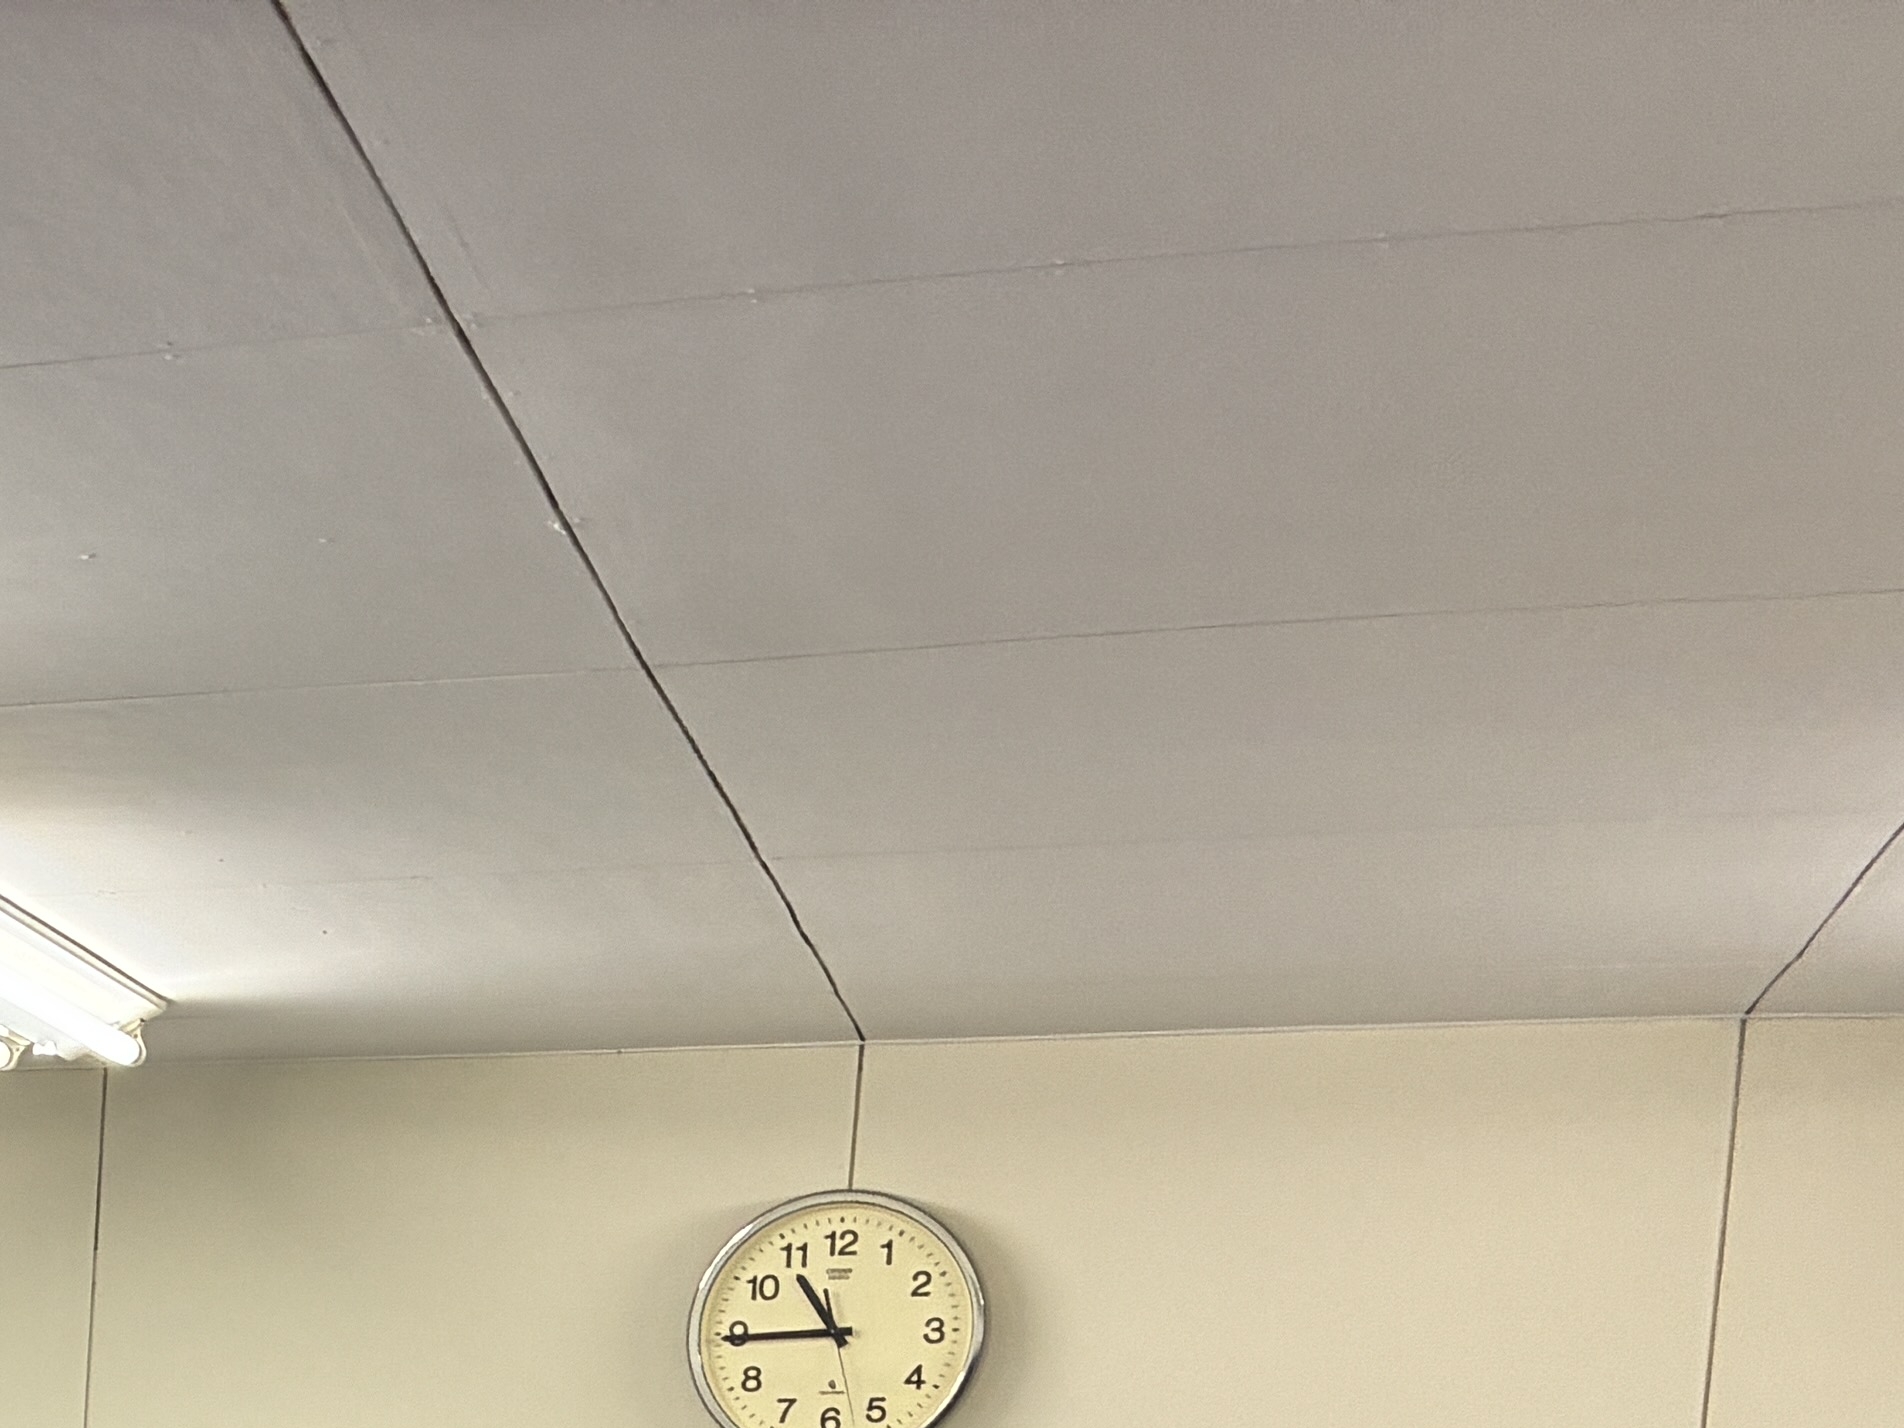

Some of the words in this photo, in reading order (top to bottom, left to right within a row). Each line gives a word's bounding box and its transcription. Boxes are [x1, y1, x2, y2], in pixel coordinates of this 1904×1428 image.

[780, 1243, 809, 1268] 11
[825, 1230, 859, 1256] 12
[880, 1239, 894, 1265] 1
[747, 1275, 780, 1300] 10
[911, 1271, 932, 1297] 2
[728, 1320, 749, 1346] 9
[923, 1318, 945, 1343] 3
[741, 1366, 763, 1392] 8
[904, 1365, 925, 1390] 4
[777, 1398, 797, 1423] 7
[866, 1397, 887, 1423] 5
